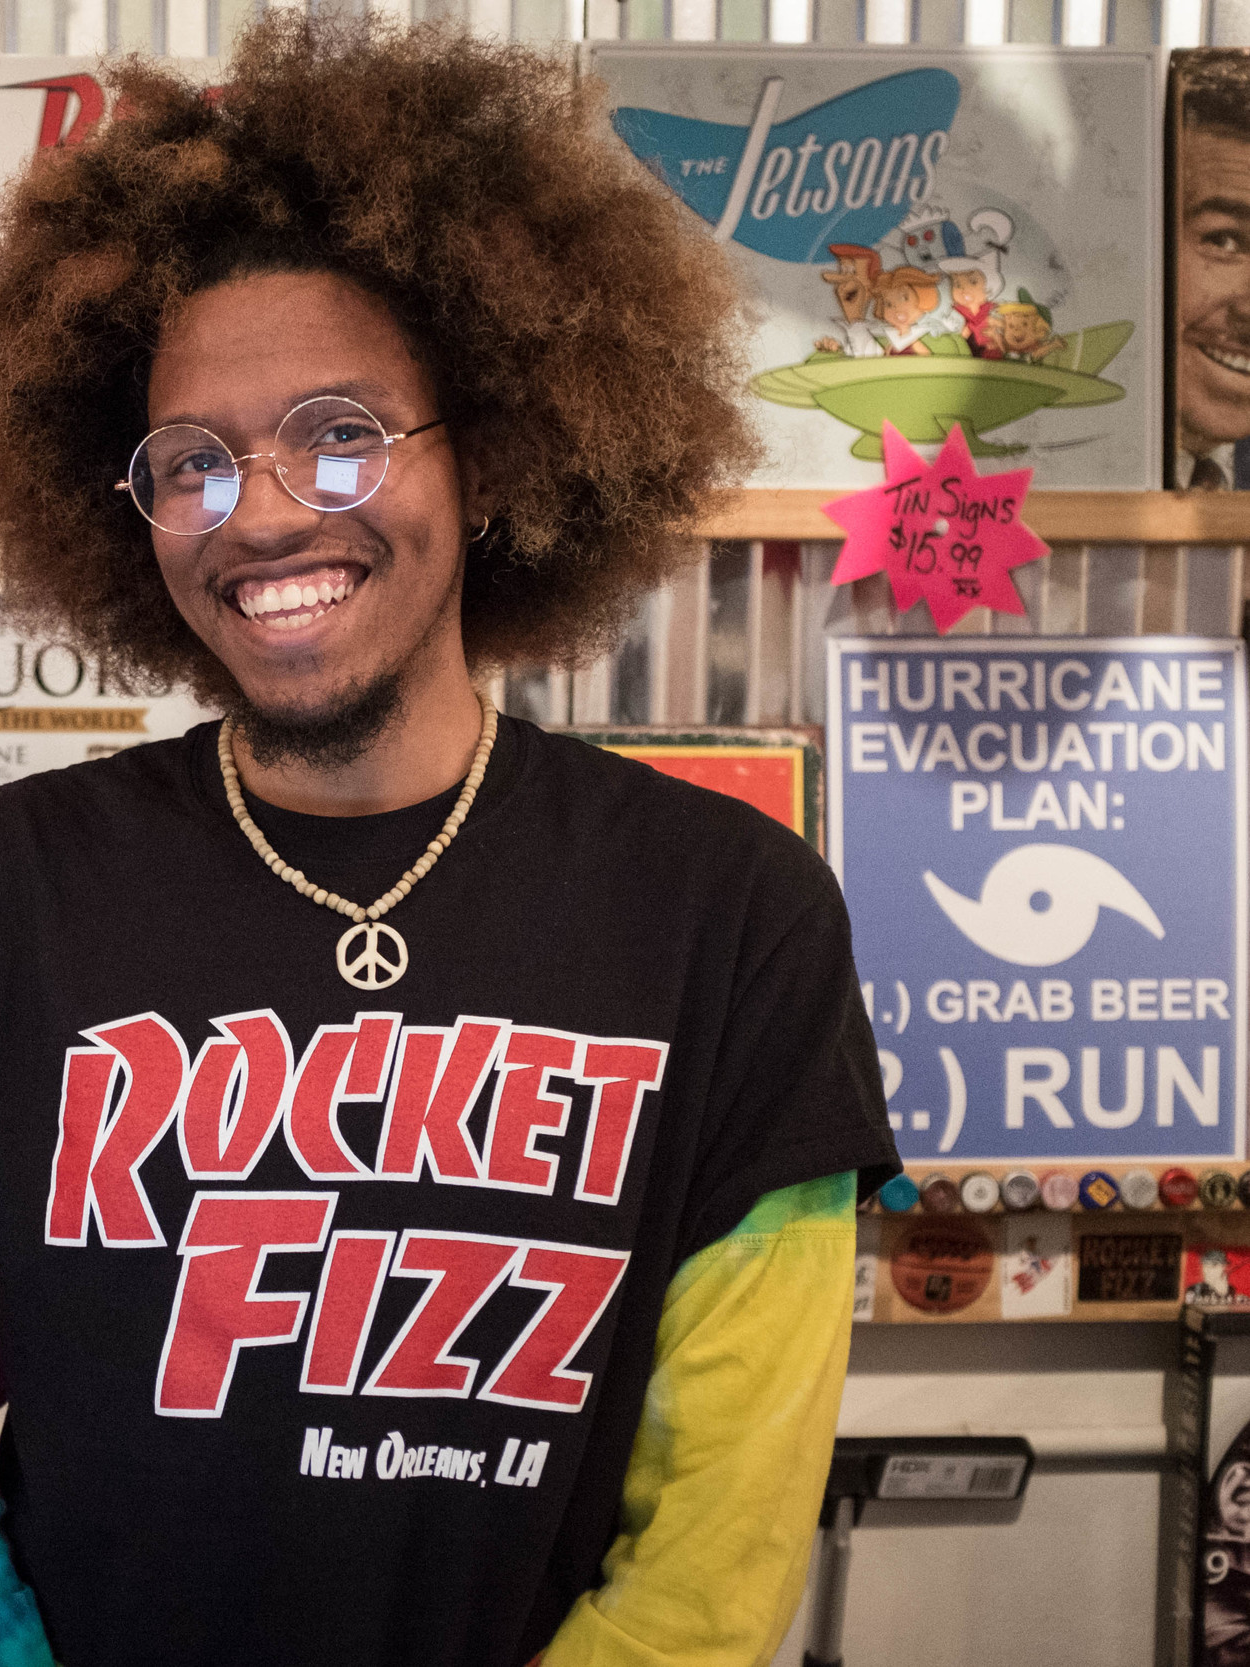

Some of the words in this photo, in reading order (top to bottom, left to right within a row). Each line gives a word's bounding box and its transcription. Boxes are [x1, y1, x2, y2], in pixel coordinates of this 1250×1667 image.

[681, 157, 730, 177] THE
[715, 76, 948, 240] Jetsons
[849, 660, 1225, 711] HURRICANE
[0, 709, 41, 729] THE
[52, 709, 138, 730] WORLD
[851, 722, 1225, 773] EVACUATION
[952, 780, 1125, 831] PLAN:
[926, 979, 1075, 1023] GRAB
[1091, 979, 1231, 1021] BEER
[1004, 1046, 1219, 1129] RUN
[45, 1008, 670, 1248] ROCKET
[154, 1191, 631, 1418] FIZZ
[494, 1437, 550, 1488] LA
